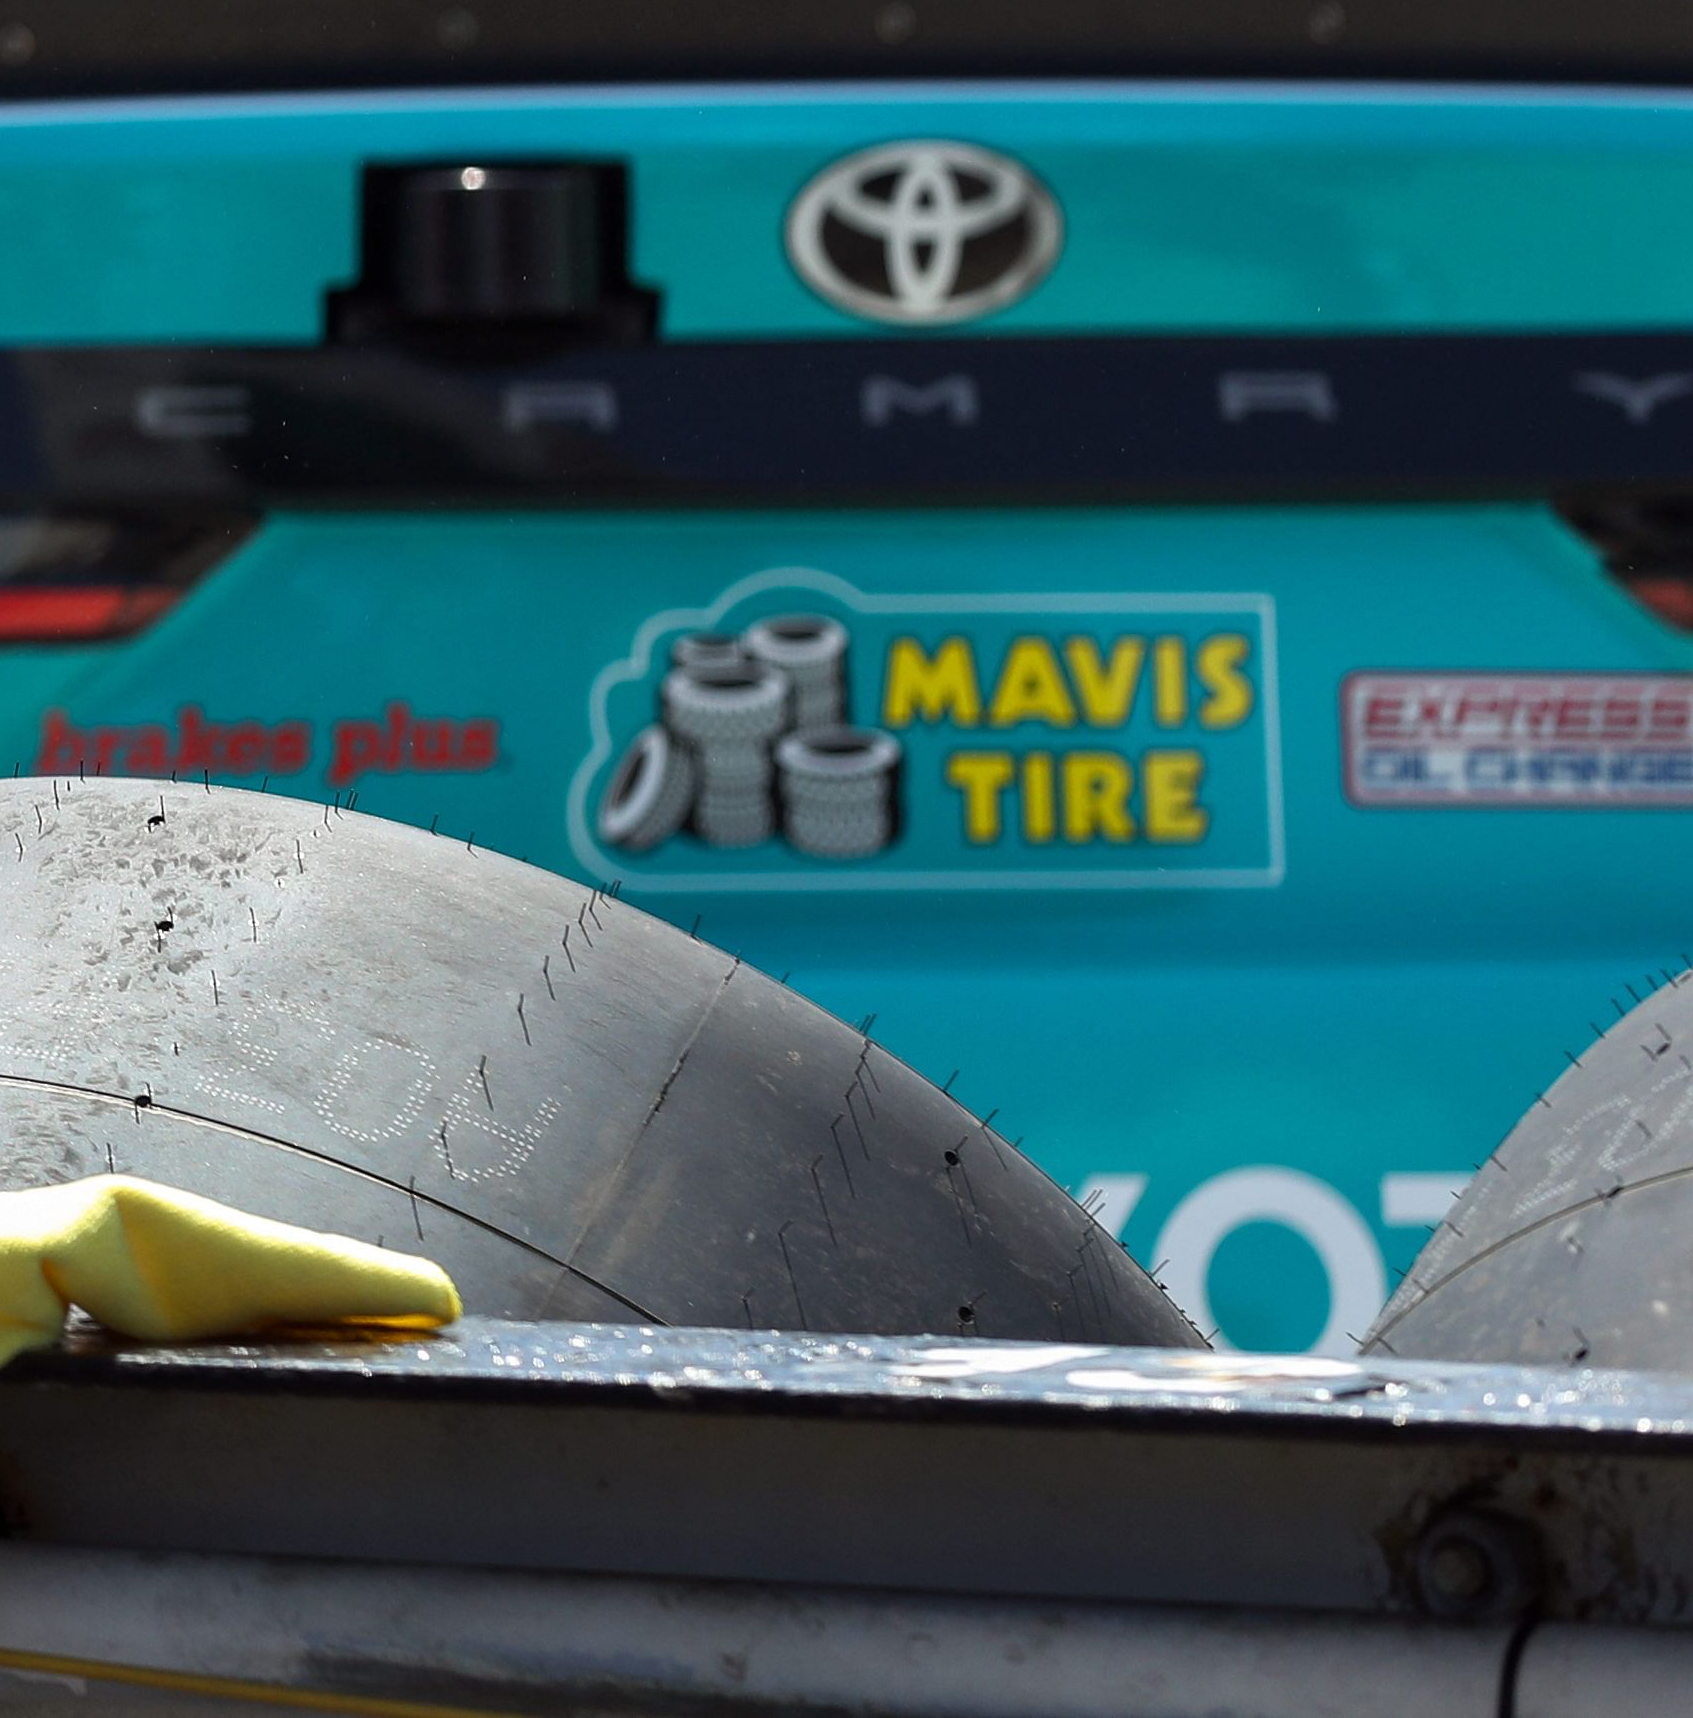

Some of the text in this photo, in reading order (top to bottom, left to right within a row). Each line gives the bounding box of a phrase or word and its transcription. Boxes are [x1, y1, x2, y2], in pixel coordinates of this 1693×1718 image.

[883, 630, 1256, 734] MAVIS
[37, 699, 500, 787] brakes plus
[944, 748, 1211, 848] TIRE
